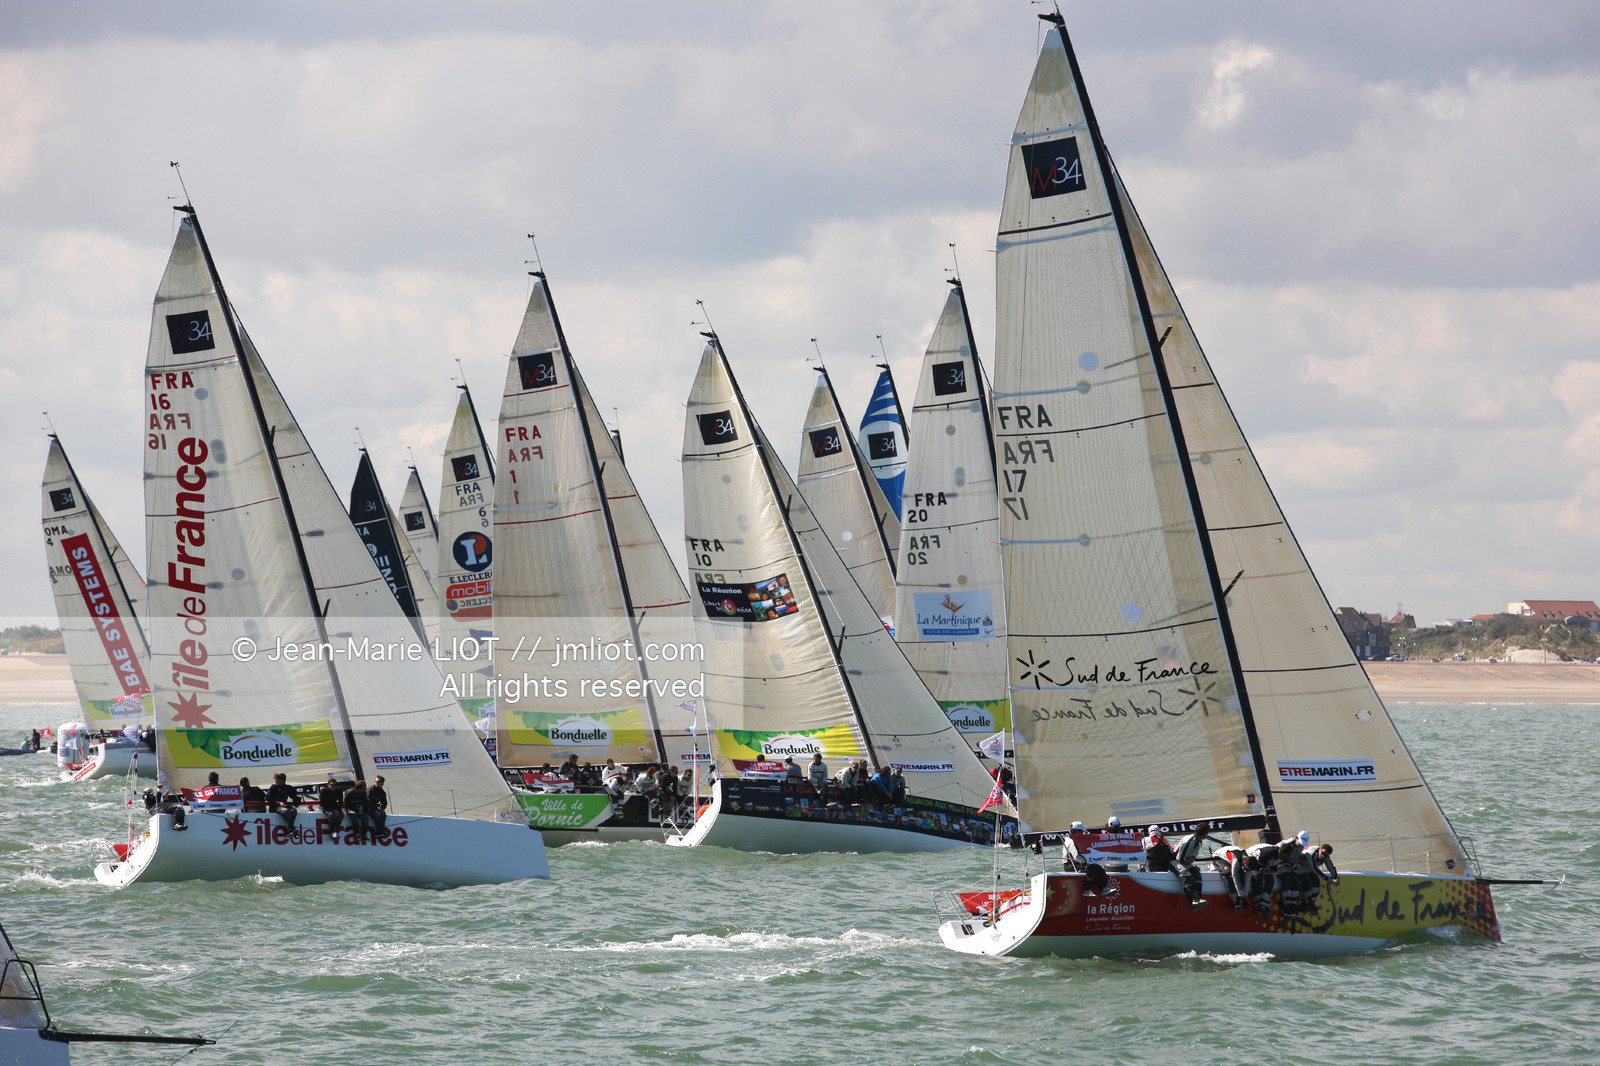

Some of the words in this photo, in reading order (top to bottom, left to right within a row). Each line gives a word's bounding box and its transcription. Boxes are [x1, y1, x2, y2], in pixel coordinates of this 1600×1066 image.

[1032, 157, 1082, 192] M34
[151, 371, 194, 390] FRA
[524, 364, 555, 386] M34
[151, 393, 171, 410] 16
[998, 404, 1053, 429] FRA
[505, 425, 542, 442] FRA
[510, 470, 517, 483] 1
[1003, 469, 1027, 492] 17
[455, 482, 481, 496] FRA
[914, 492, 947, 507] FRA
[479, 507, 487, 517] 6
[908, 509, 928, 523] 20
[45, 525, 68, 536] OMA
[47, 538, 54, 547] 4
[690, 538, 725, 552] FRA
[695, 553, 712, 567] 10
[72, 546, 121, 642] SYSTEMS
[917, 614, 929, 625] La
[932, 614, 981, 629] Martinique
[117, 648, 140, 687] BAE
[1055, 657, 1098, 686] Sud
[1106, 666, 1130, 682] de
[1135, 657, 1218, 683] France
[951, 716, 991, 729] onduelle
[551, 728, 607, 743] Bonduelle
[221, 738, 292, 762] Bonduelle
[763, 743, 820, 756] Bonduelle
[373, 752, 449, 764] ETREMARIN.FR
[1278, 766, 1375, 777] ETREMARIN.FR
[215, 787, 239, 796] FRANCE
[541, 798, 567, 811] Ville
[571, 799, 583, 810] de
[524, 806, 583, 826] Pornic
[1087, 905, 1097, 914] la
[1100, 903, 1135, 915] Région
[1312, 876, 1365, 932] Sud
[1376, 890, 1406, 921] de
[1408, 880, 1496, 924] France
